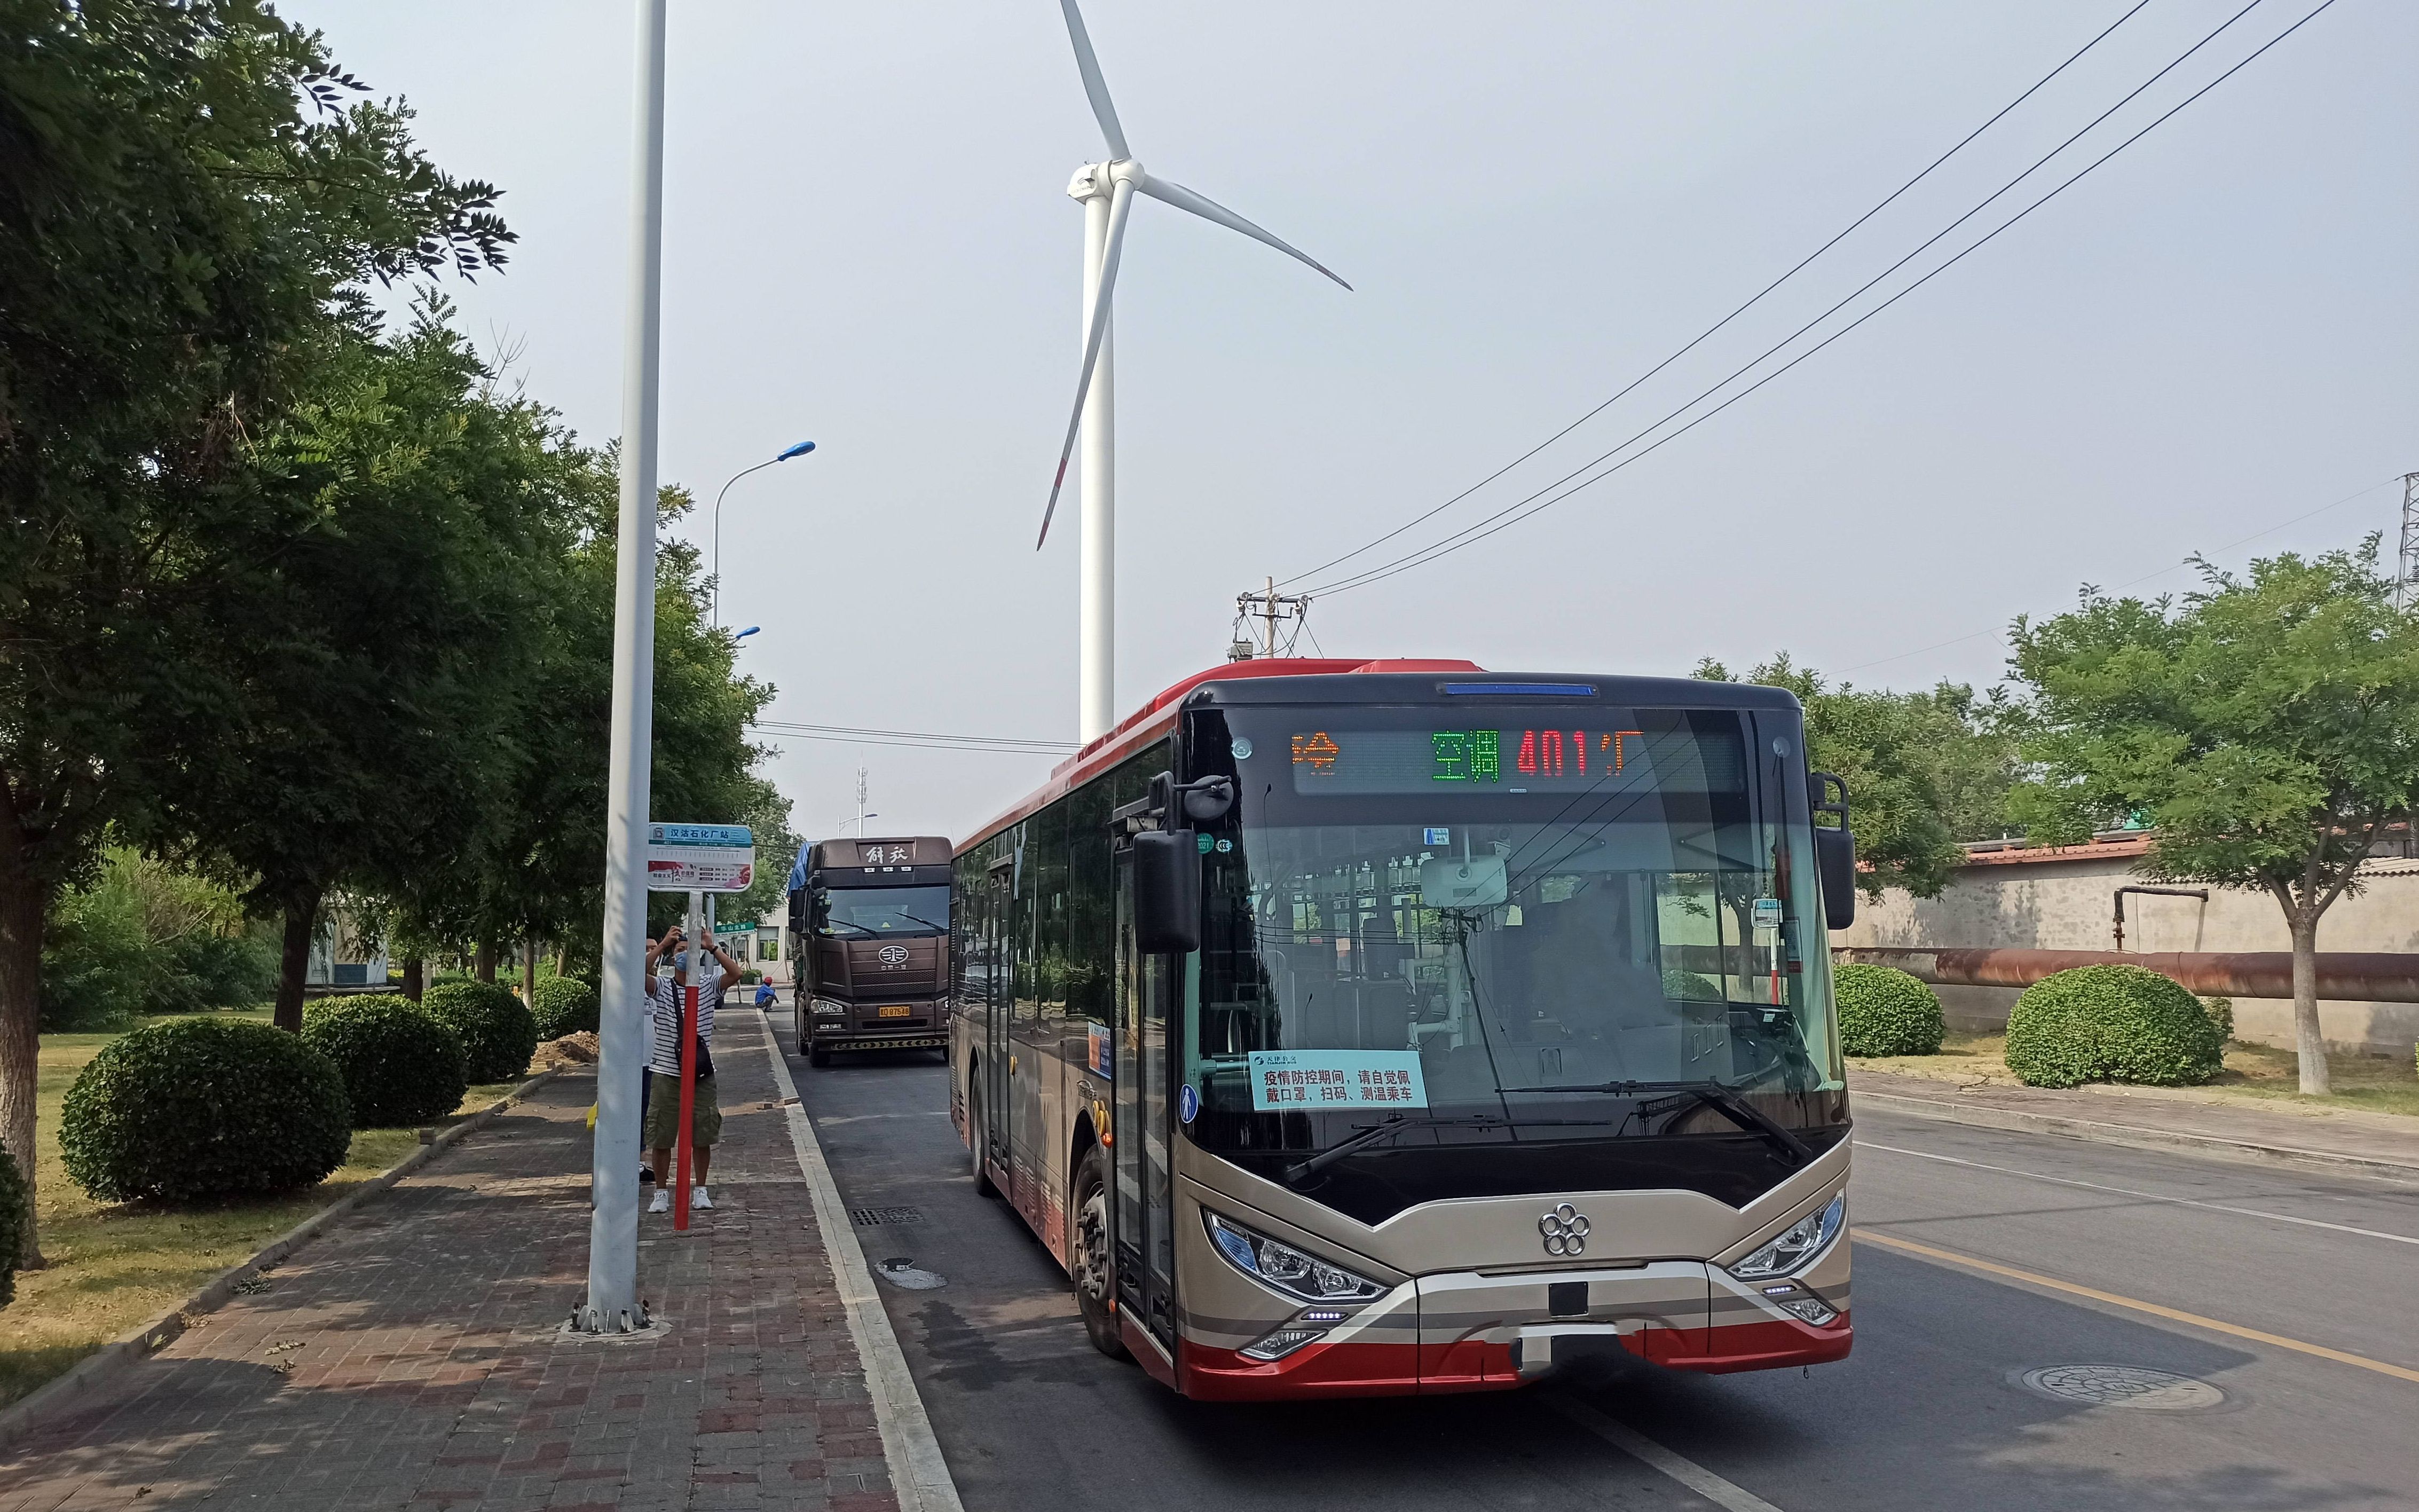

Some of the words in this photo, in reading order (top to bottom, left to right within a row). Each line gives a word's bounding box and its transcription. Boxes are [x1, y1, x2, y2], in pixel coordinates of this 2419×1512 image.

[1432, 729, 1499, 783] 空调
[1517, 729, 1585, 776] 401
[671, 829, 729, 839] 汉沽石化厂站
[1264, 1069, 1411, 1085] 疫情防控期间，请自觉佩
[1266, 1087, 1413, 1103] 戴口罩，扫码、测温乘车
